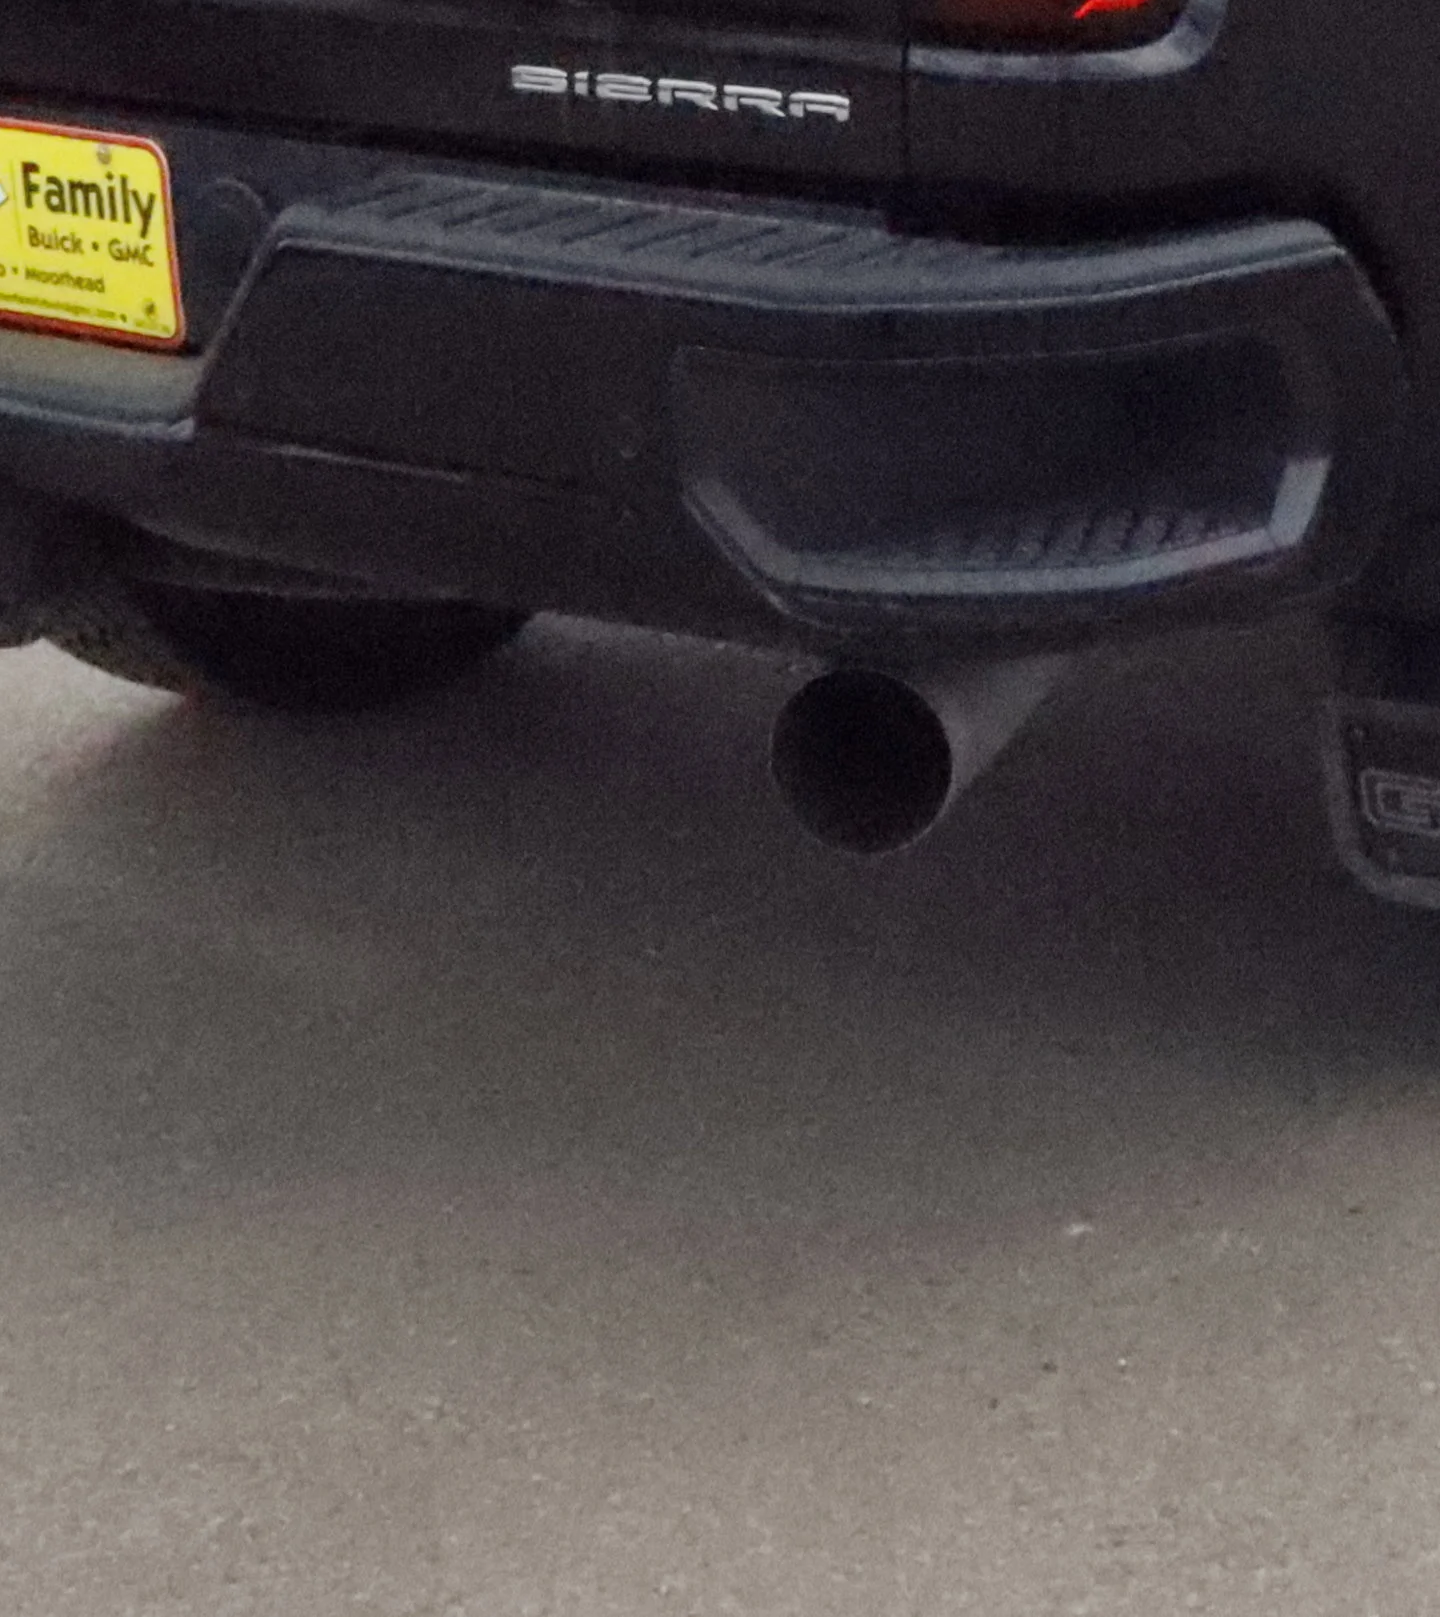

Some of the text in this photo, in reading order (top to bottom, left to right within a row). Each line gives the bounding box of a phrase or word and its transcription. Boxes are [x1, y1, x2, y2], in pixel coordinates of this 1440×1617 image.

[510, 64, 851, 122] SIERRA
[21, 161, 157, 239] Family
[28, 226, 155, 268] Buick GMC
[24, 266, 106, 294] Moorhead
